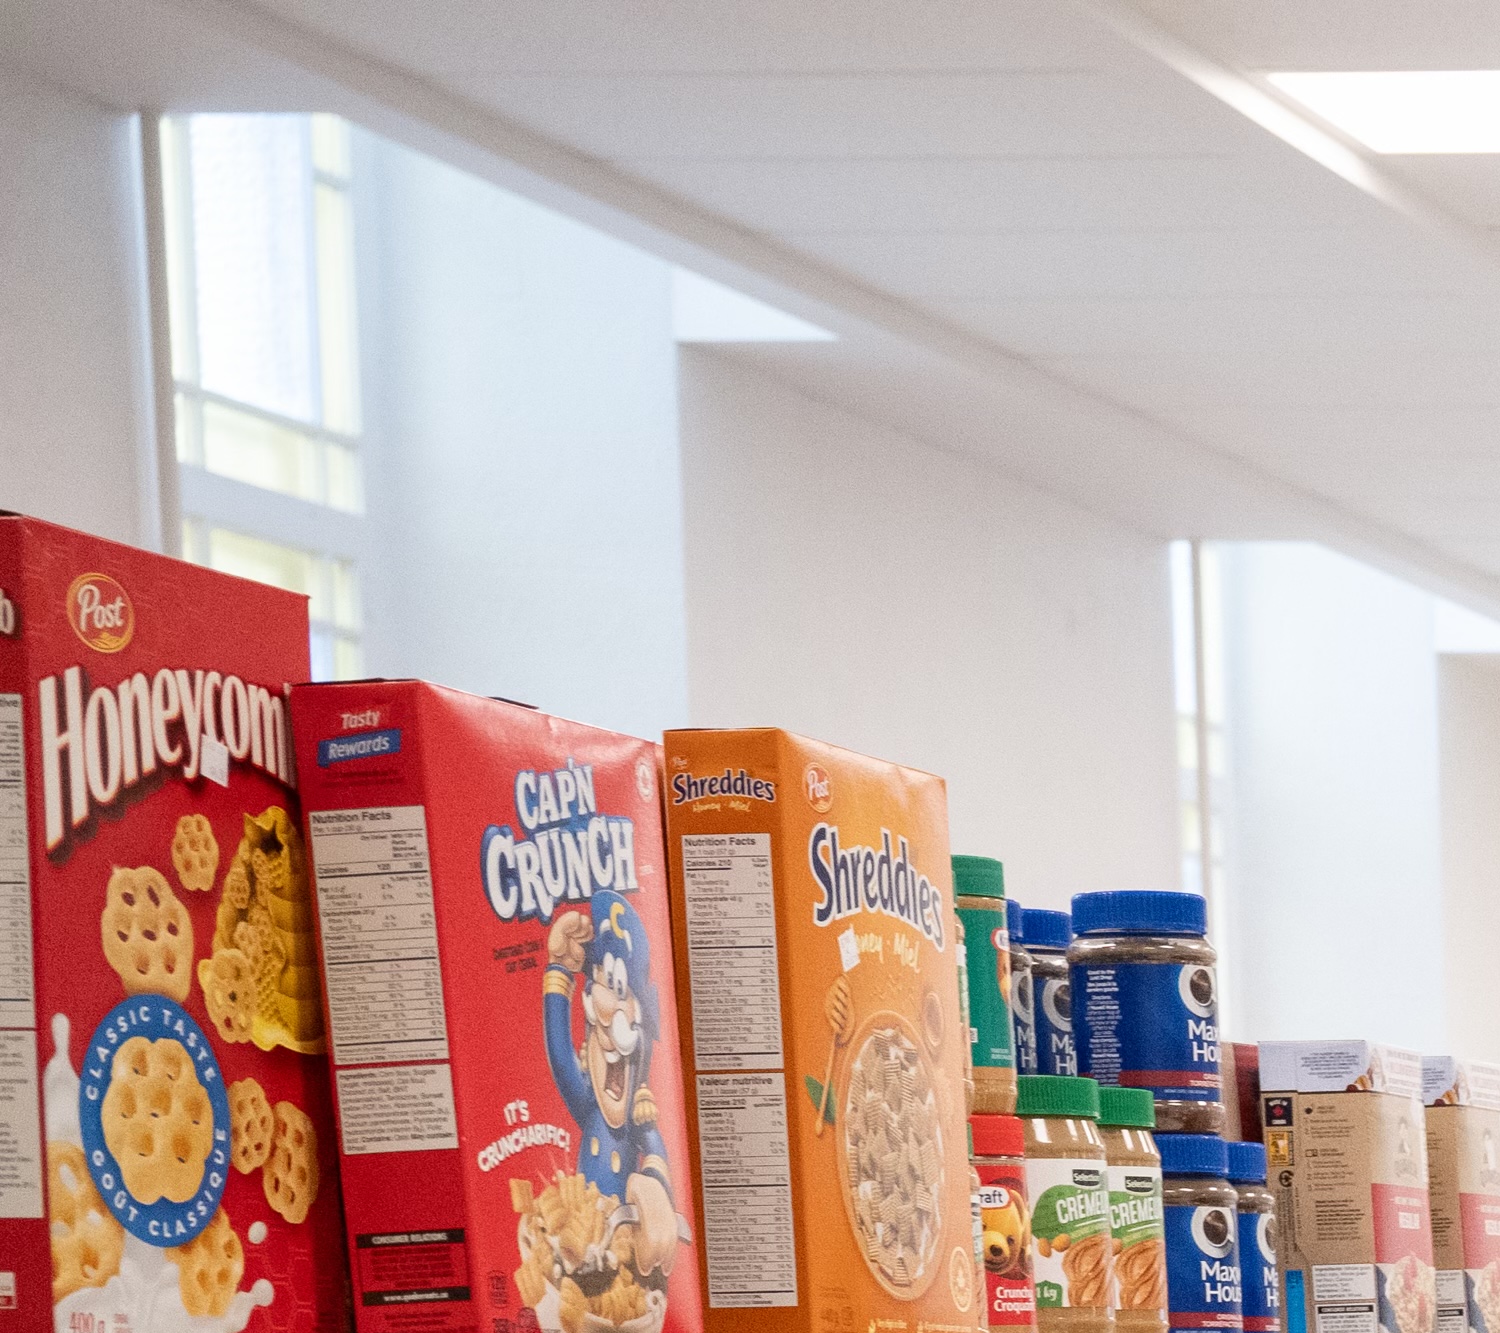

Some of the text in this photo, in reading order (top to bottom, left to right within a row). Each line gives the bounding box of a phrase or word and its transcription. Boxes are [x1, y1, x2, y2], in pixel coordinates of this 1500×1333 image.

[78, 585, 125, 632] Post
[341, 709, 382, 730] Tasty
[39, 666, 293, 850] Honeycom
[328, 735, 390, 759] Rewards
[673, 769, 775, 804] Shreddies
[806, 770, 830, 799] Post
[312, 811, 392, 824] Nutrition Facts
[684, 836, 756, 848] Nutrition Facts
[485, 817, 640, 920] CRUNCH
[811, 825, 945, 950] Shreddies
[85, 1005, 218, 1101] CLASSIC TASTE
[149, 1128, 227, 1239] CLASSIQUE
